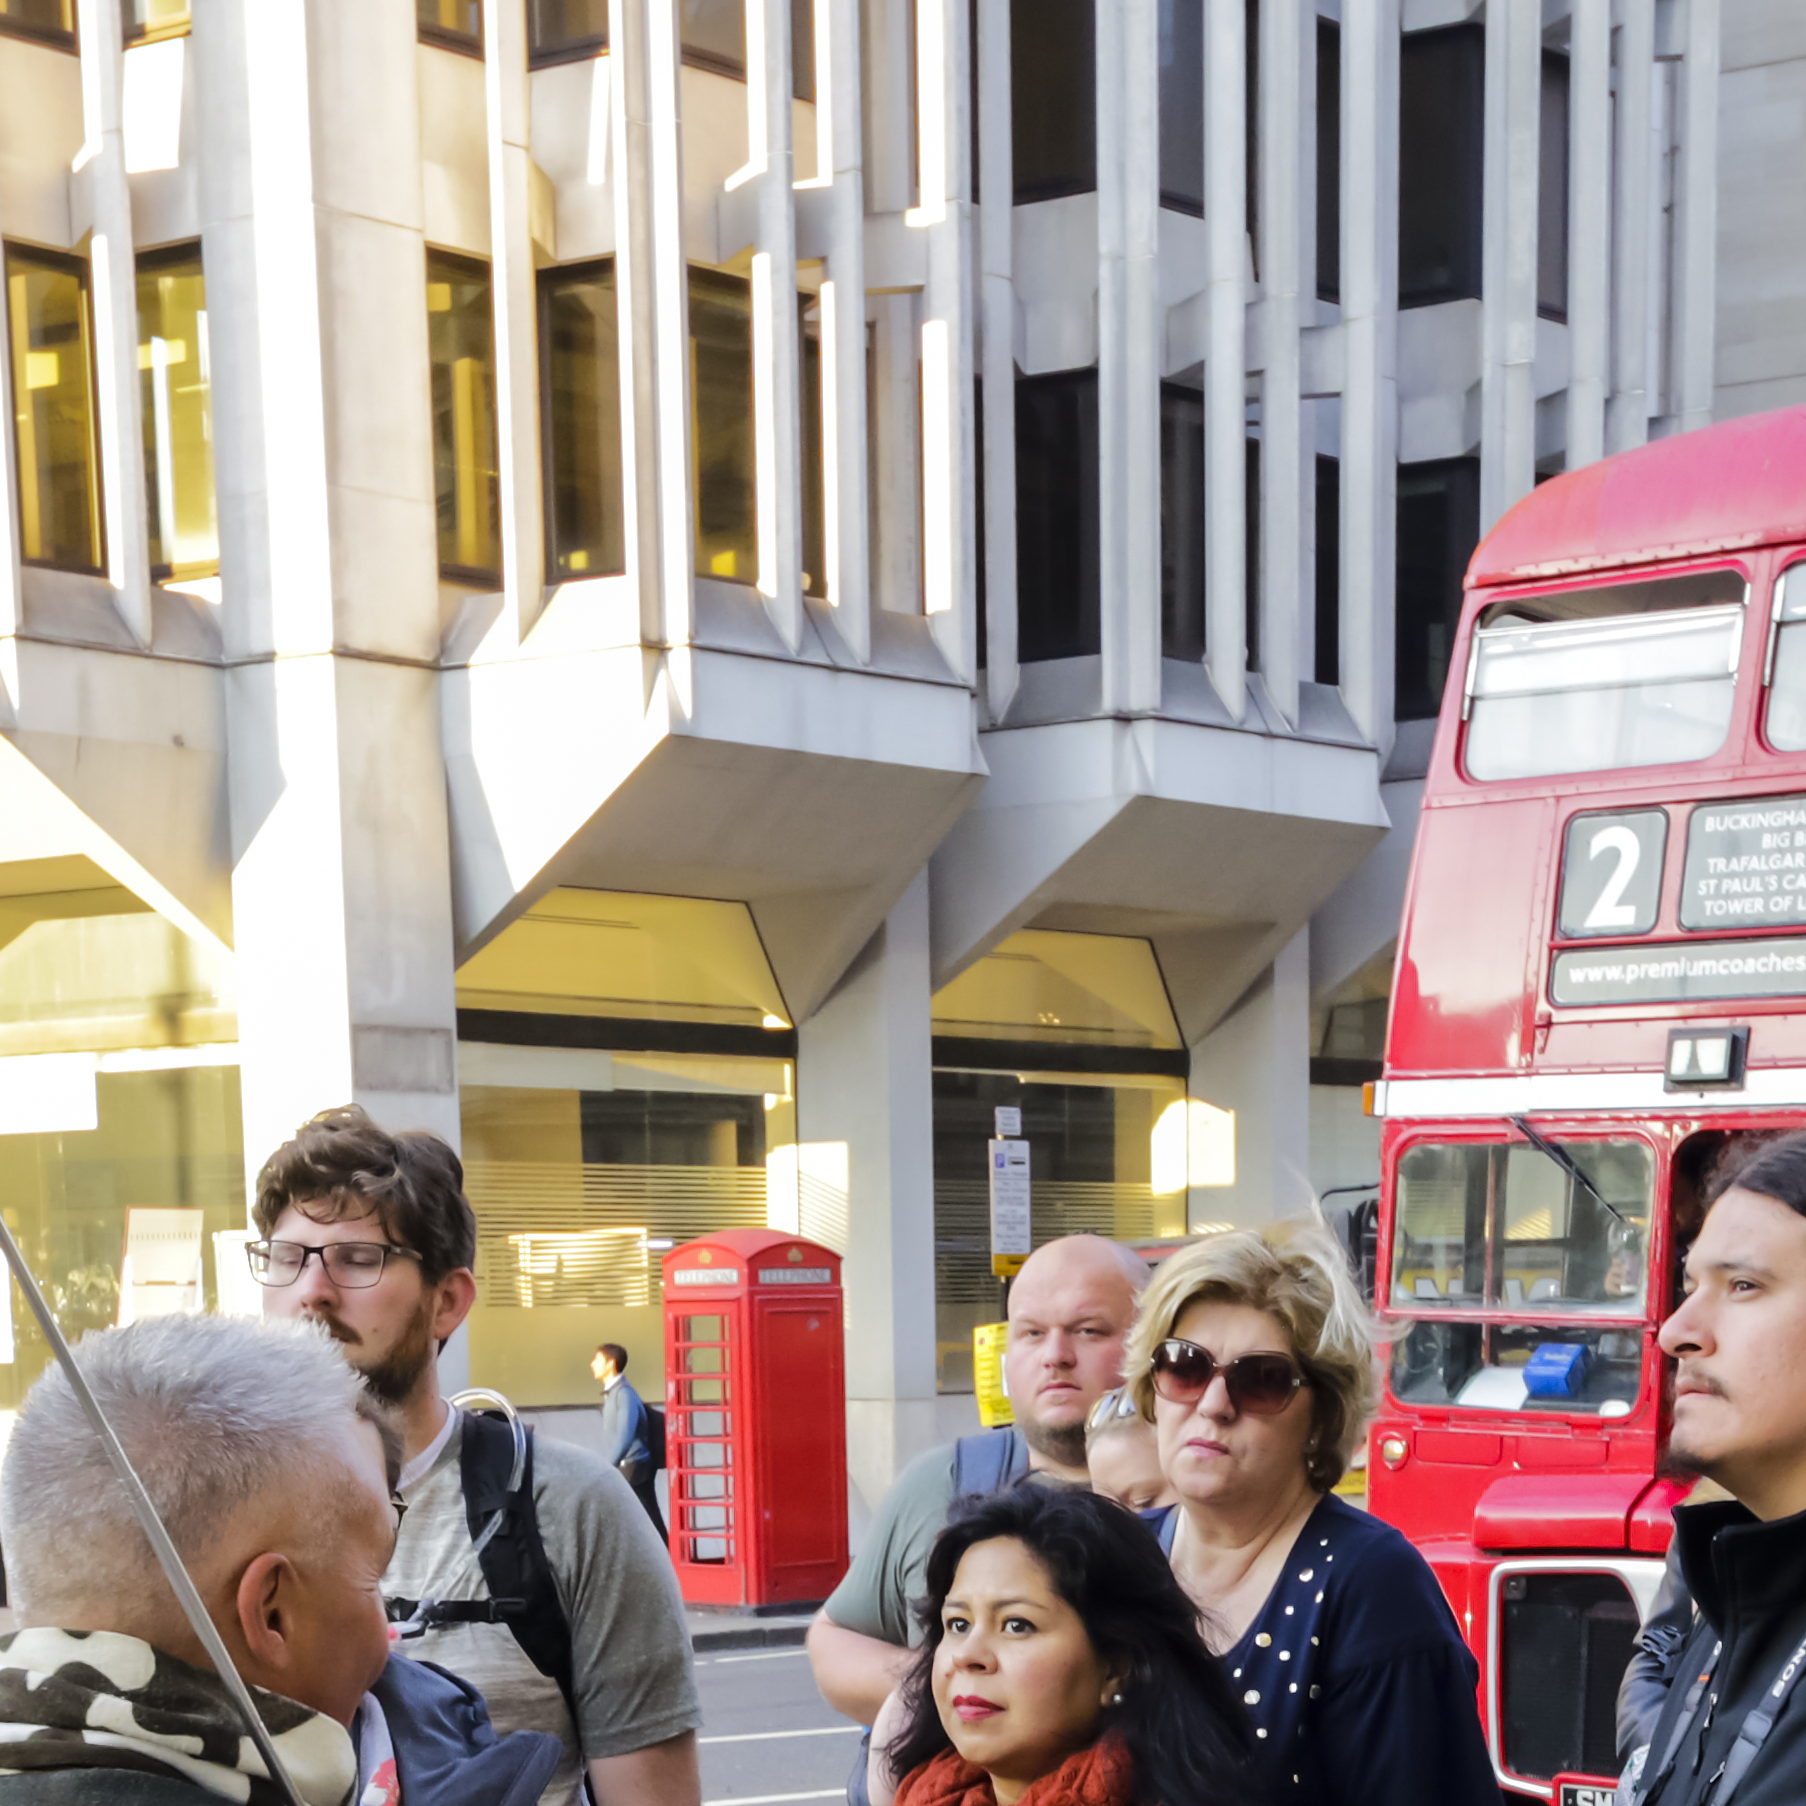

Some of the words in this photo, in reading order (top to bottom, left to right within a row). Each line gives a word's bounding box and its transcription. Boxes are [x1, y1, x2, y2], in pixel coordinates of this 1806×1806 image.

[1761, 831, 1791, 850] BIG
[1707, 851, 1806, 874] TRAFALGAR
[1583, 825, 1642, 929] 2
[1697, 879, 1719, 896] ST
[1721, 874, 1779, 895] PAUL'S
[1704, 896, 1765, 917] TOWER
[1769, 894, 1795, 913] OF
